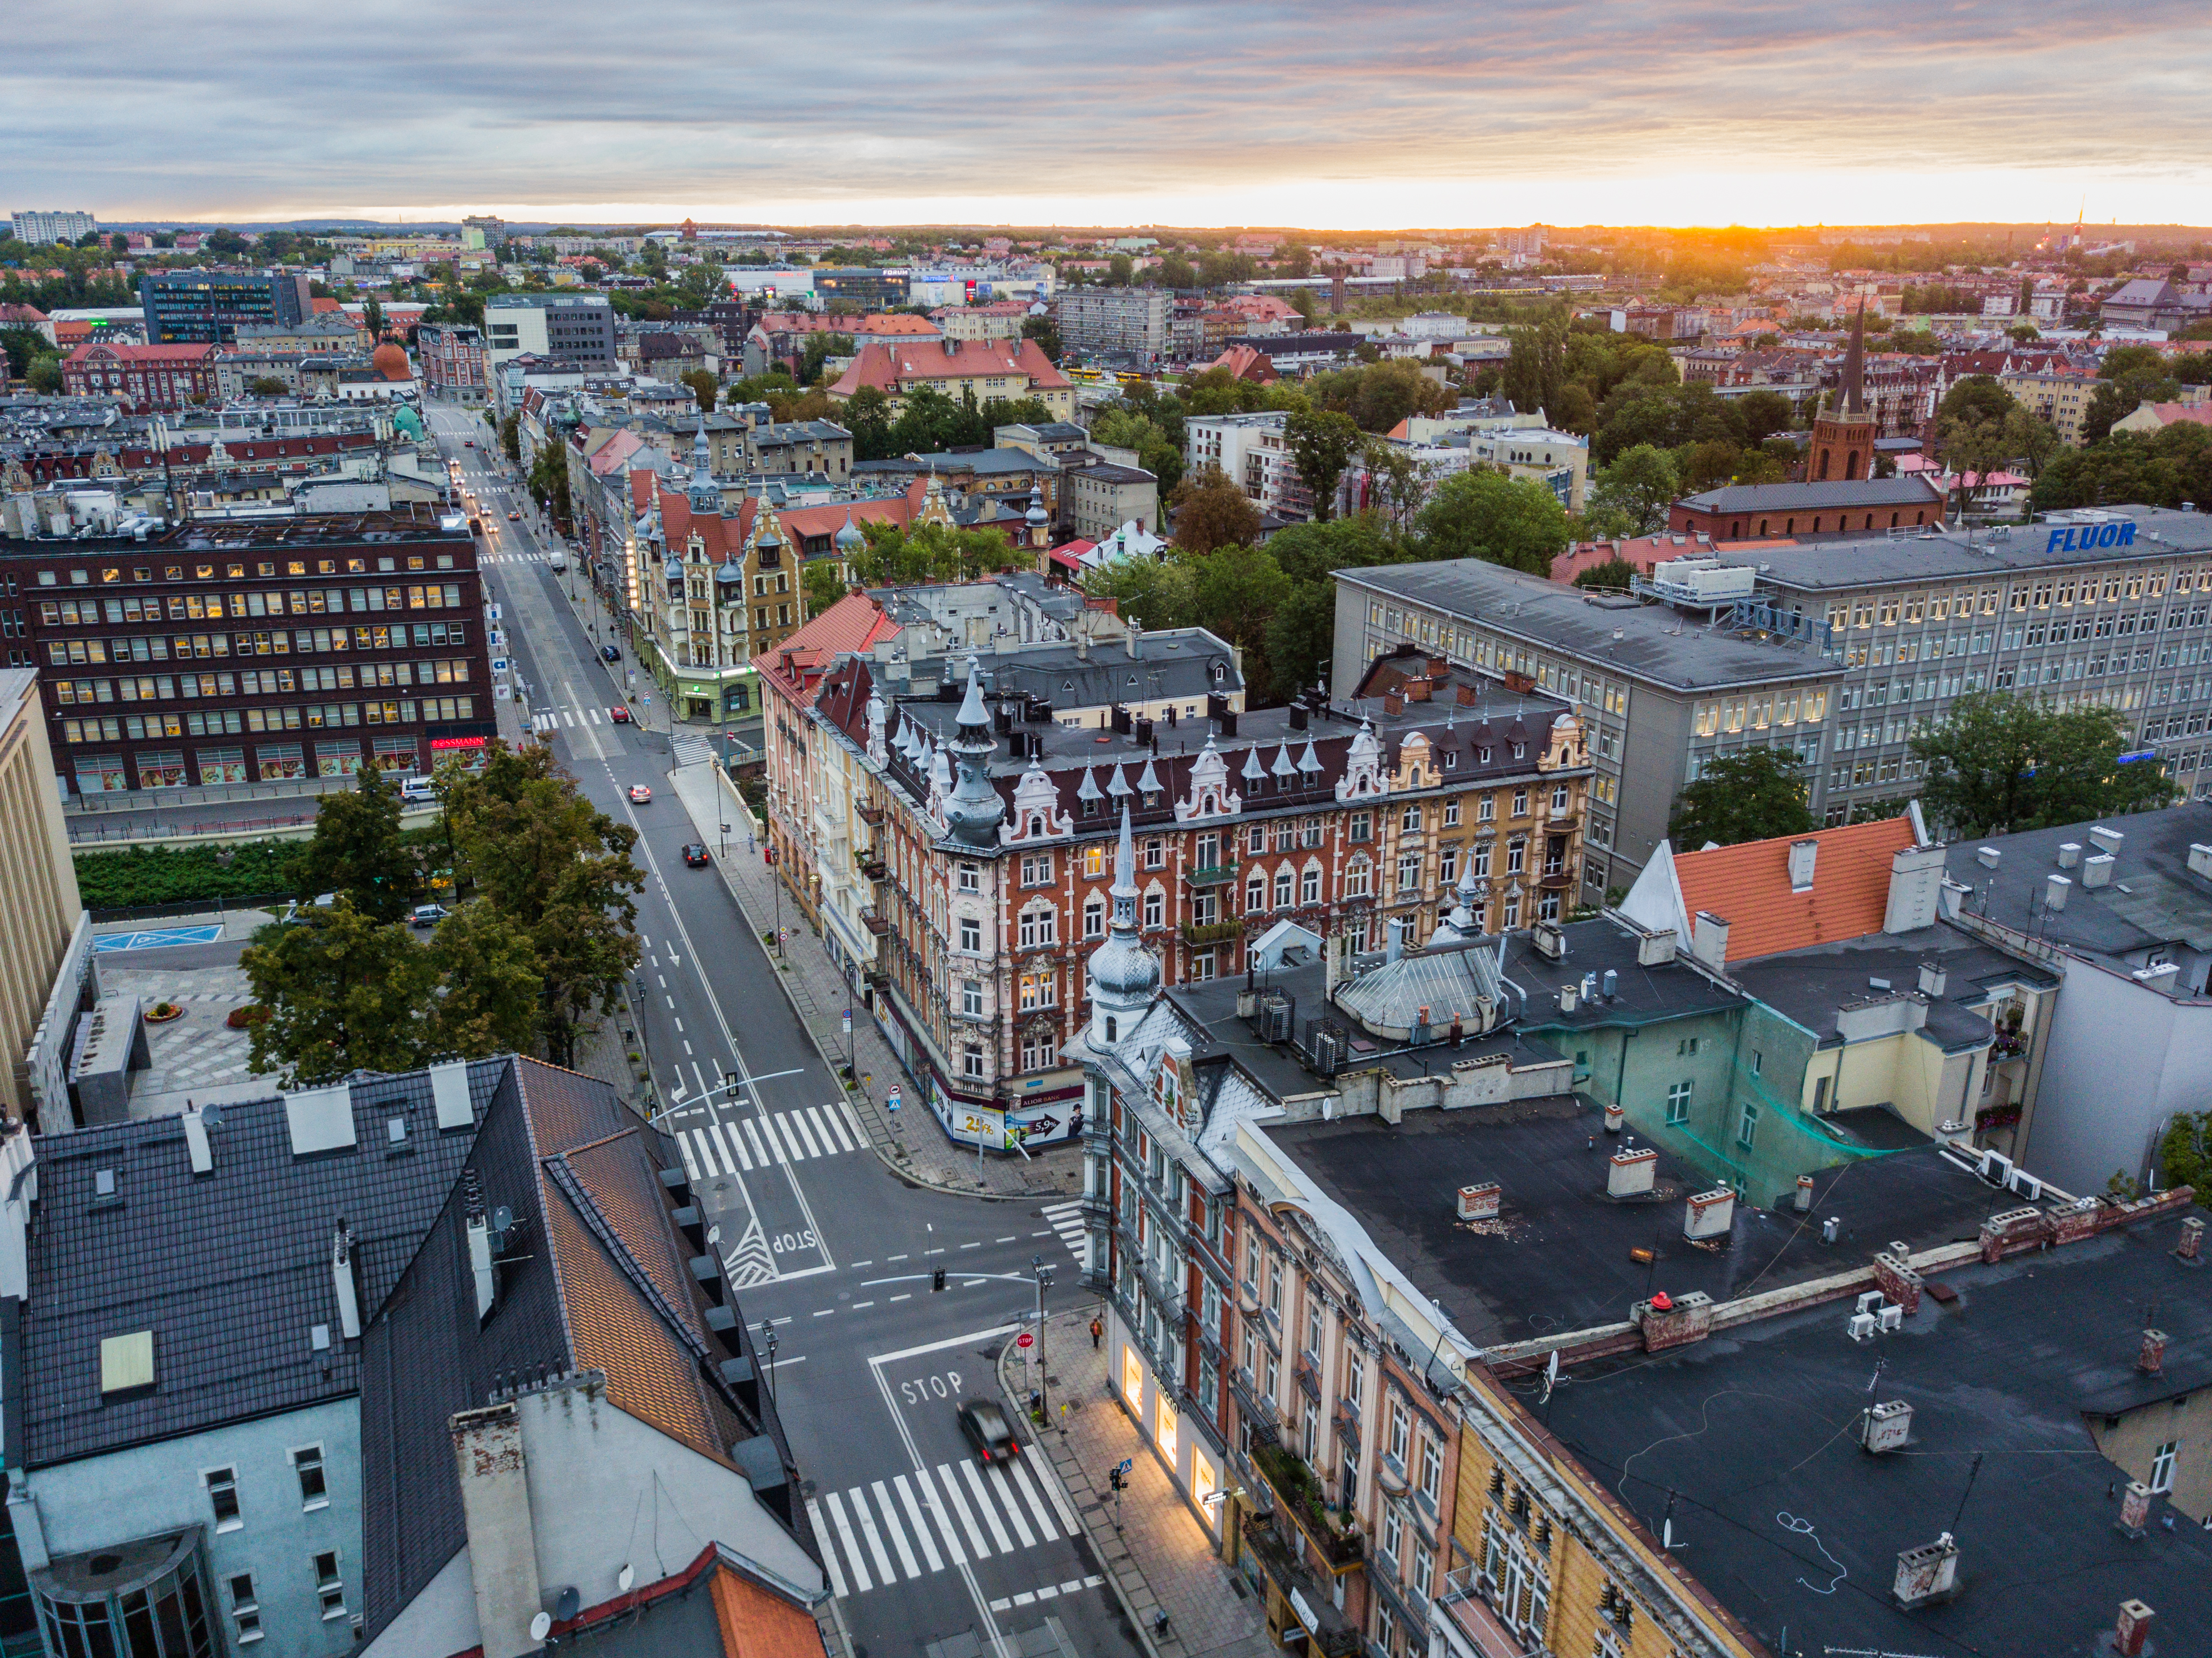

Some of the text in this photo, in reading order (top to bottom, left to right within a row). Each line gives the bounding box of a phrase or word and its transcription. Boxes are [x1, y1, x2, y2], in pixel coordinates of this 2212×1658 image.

[2045, 522, 2137, 553] FLUOR
[432, 737, 483, 747] ROSSMANN
[1023, 1098, 1043, 1106] ALIOR
[1043, 1094, 1060, 1103] BANK
[1035, 1120, 1057, 1132] 5,9%
[773, 1230, 816, 1253] STOP
[901, 1371, 962, 1405] STOP
[1292, 1592, 1316, 1632] NOTARIUSZ
